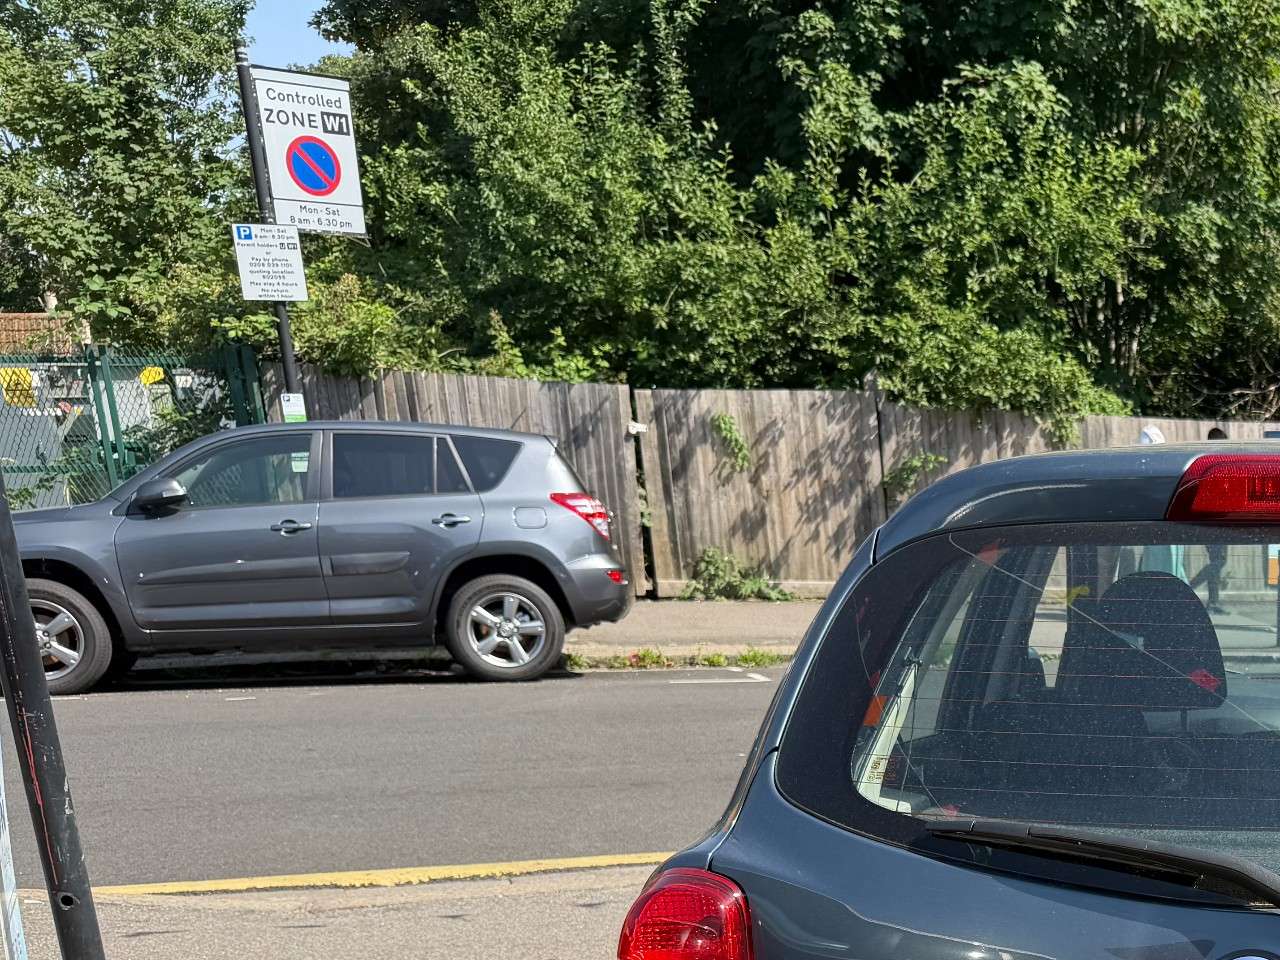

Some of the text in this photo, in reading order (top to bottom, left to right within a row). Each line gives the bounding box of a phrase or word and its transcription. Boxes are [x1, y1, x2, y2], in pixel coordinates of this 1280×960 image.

[266, 87, 342, 109] Controlled
[263, 108, 348, 134] ZONE W1
[299, 205, 319, 215] Mon
[325, 207, 341, 217] Sat
[290, 216, 296, 224] 8
[317, 219, 338, 227] 6.30
[339, 221, 353, 229] pm
[240, 226, 250, 239] P
